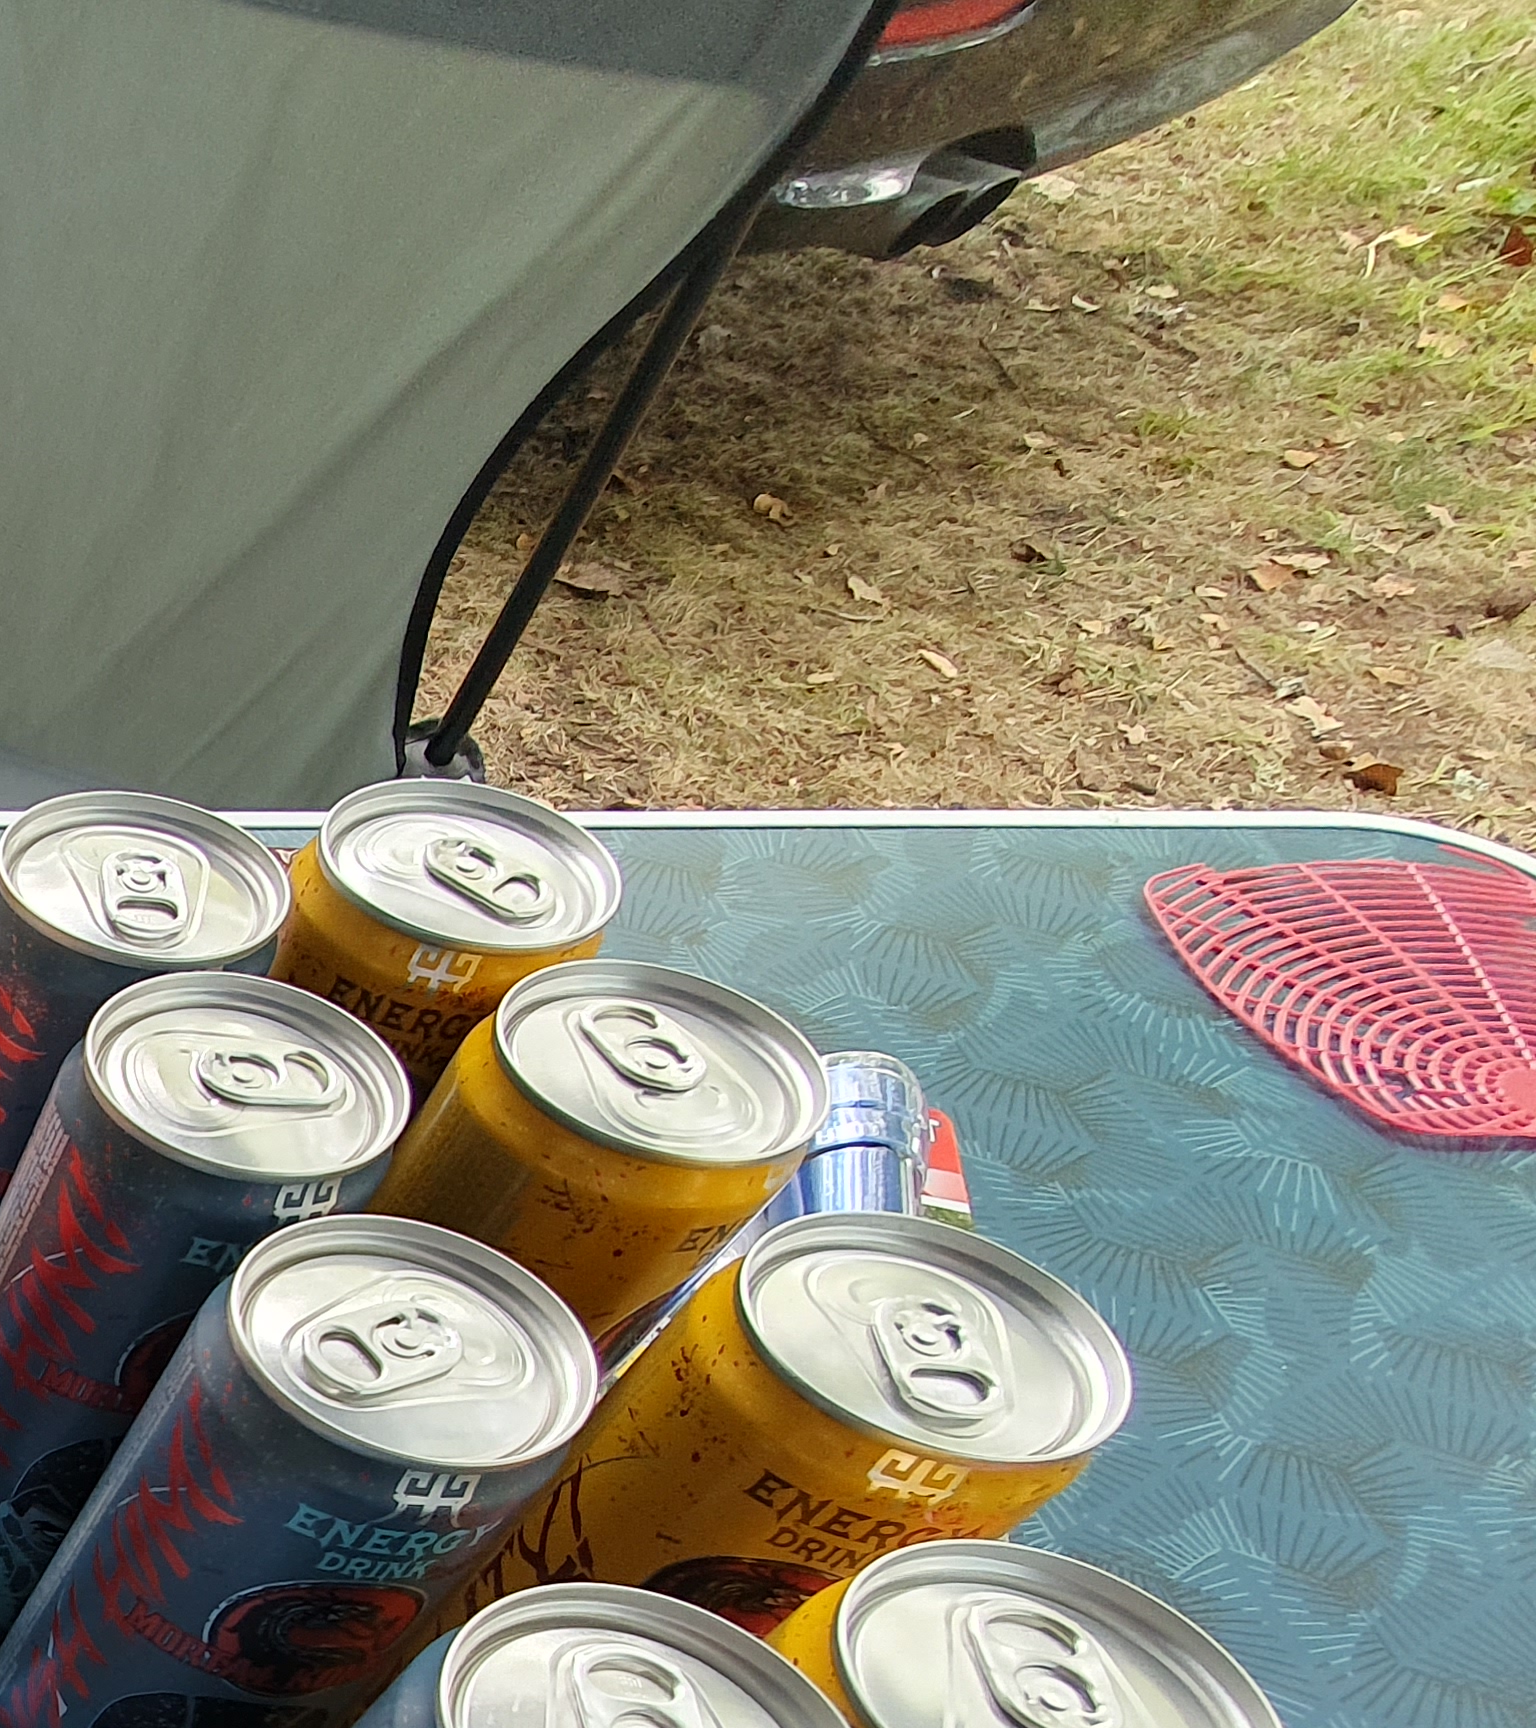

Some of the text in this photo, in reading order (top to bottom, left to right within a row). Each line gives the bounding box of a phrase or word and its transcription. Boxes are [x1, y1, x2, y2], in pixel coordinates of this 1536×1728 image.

[94, 1378, 244, 1637] HIM!
[285, 1502, 503, 1558] ENERGY
[315, 1550, 440, 1581] DRINK
[765, 1525, 875, 1569] DRIN
